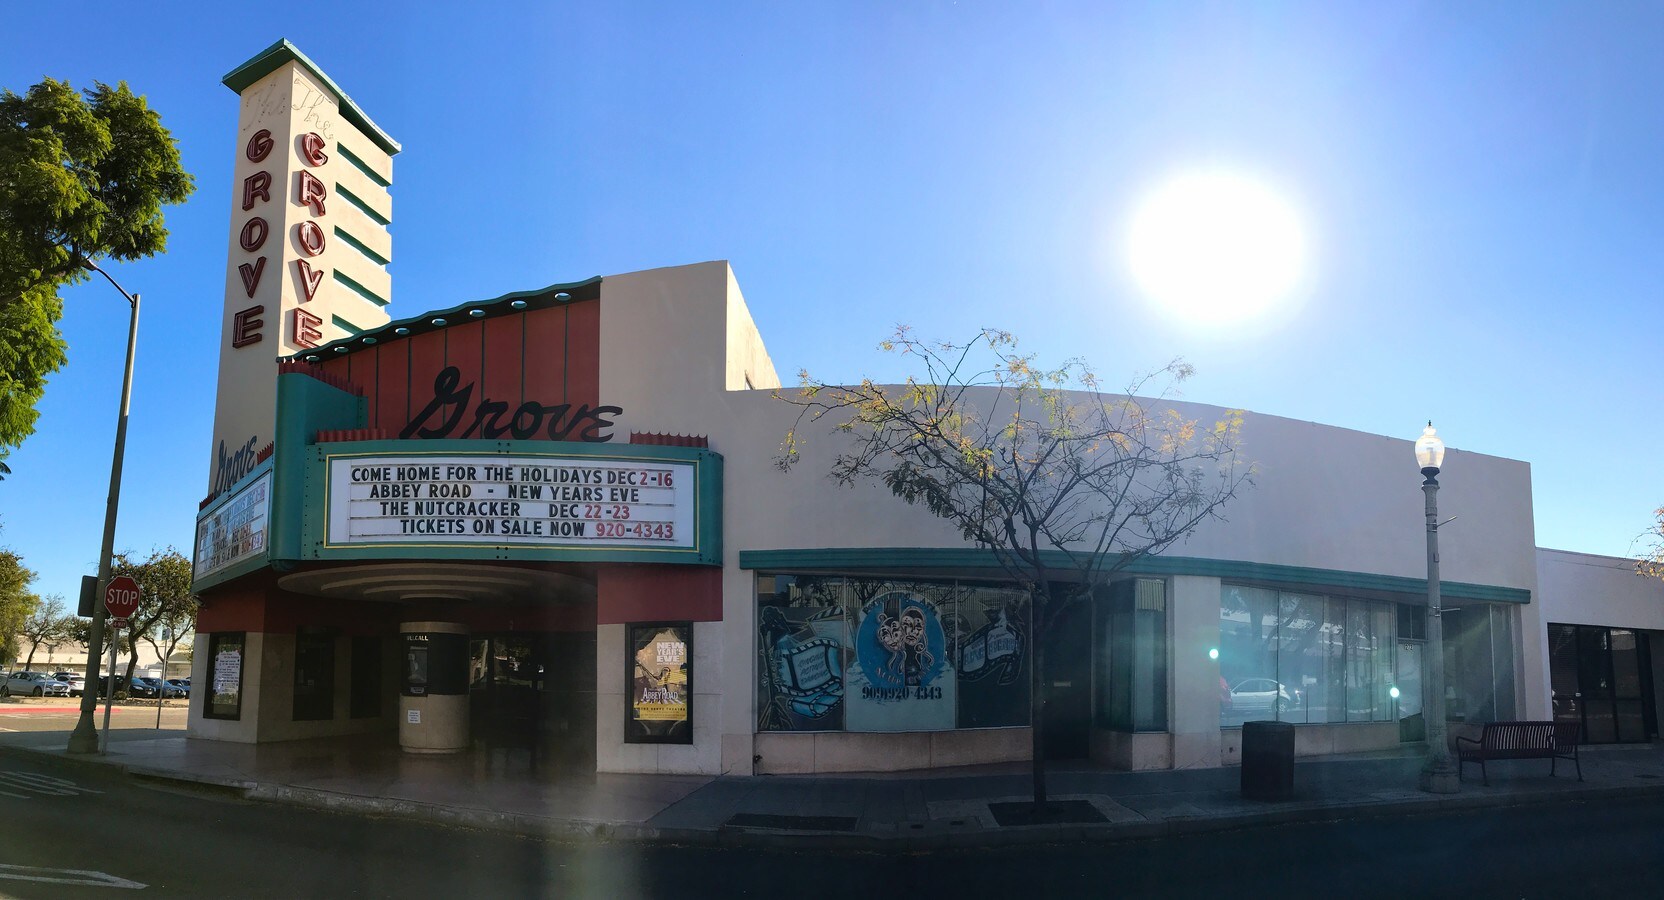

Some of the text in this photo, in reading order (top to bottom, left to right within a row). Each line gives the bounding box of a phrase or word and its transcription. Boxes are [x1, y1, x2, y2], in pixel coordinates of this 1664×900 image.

[232, 128, 275, 348] GROVE
[293, 131, 329, 349] GROVE
[399, 365, 624, 444] Grove
[351, 465, 673, 487] COME HOME FOR THE HOLIDAYS DEC 2-16
[370, 483, 422, 499] ABBEY
[429, 483, 472, 498] ROAD
[508, 484, 542, 500] NEW
[550, 486, 603, 501] YEARS
[610, 488, 639, 502] EVE
[380, 501, 409, 516] THE
[414, 501, 521, 517] NUTCRACKER
[549, 503, 579, 518] DEC
[400, 518, 674, 539] TICKETS ON SALE NOW 920-4343
[107, 589, 138, 606] STOP
[656, 648, 684, 656] YEAR'S
[656, 655, 680, 663] EVE
